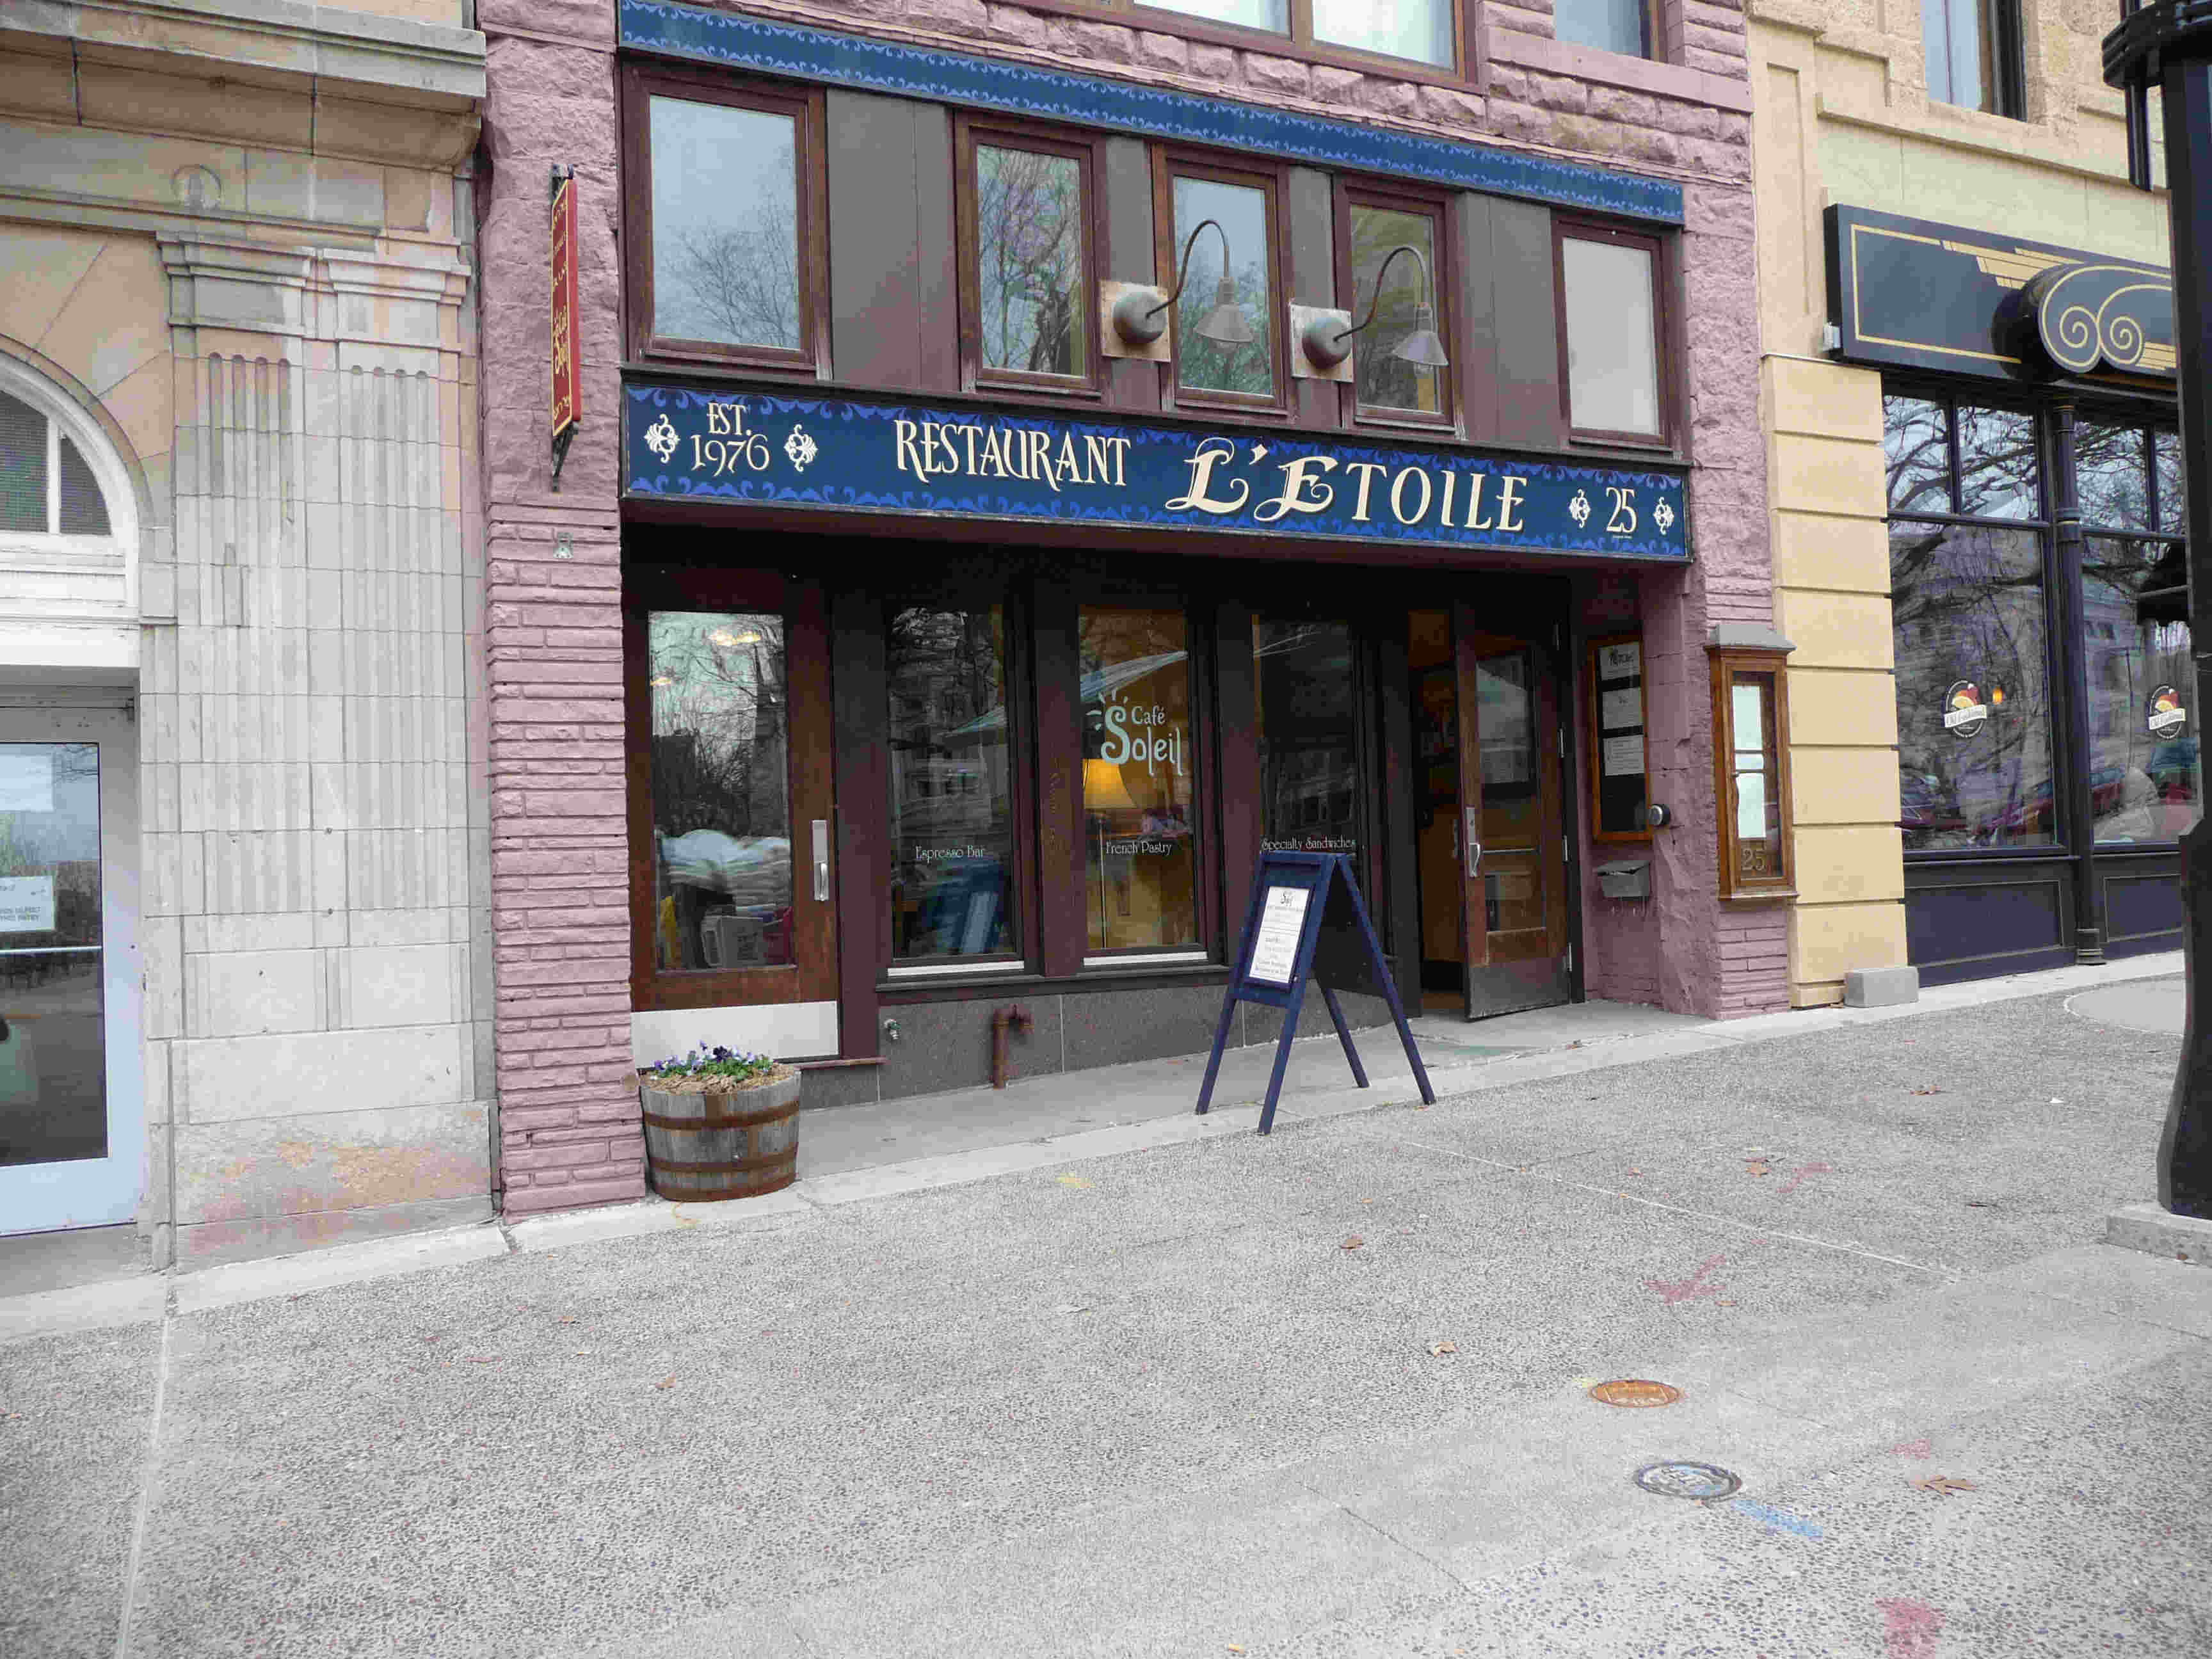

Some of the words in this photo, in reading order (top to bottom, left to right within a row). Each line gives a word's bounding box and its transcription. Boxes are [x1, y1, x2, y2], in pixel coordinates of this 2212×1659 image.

[707, 401, 752, 436] EST.
[691, 433, 770, 477] 1976
[894, 419, 1132, 492] RESTAURANT
[1164, 436, 1529, 531] L'ETOILE
[1605, 486, 1637, 533] 25
[1131, 705, 1165, 726] Café
[1100, 705, 1183, 778] Soleil
[915, 845, 963, 864] Espresso
[967, 845, 986, 860] Bar
[1105, 840, 1137, 855] French
[1141, 840, 1172, 856] Pastry
[1740, 847, 1767, 872] 25
